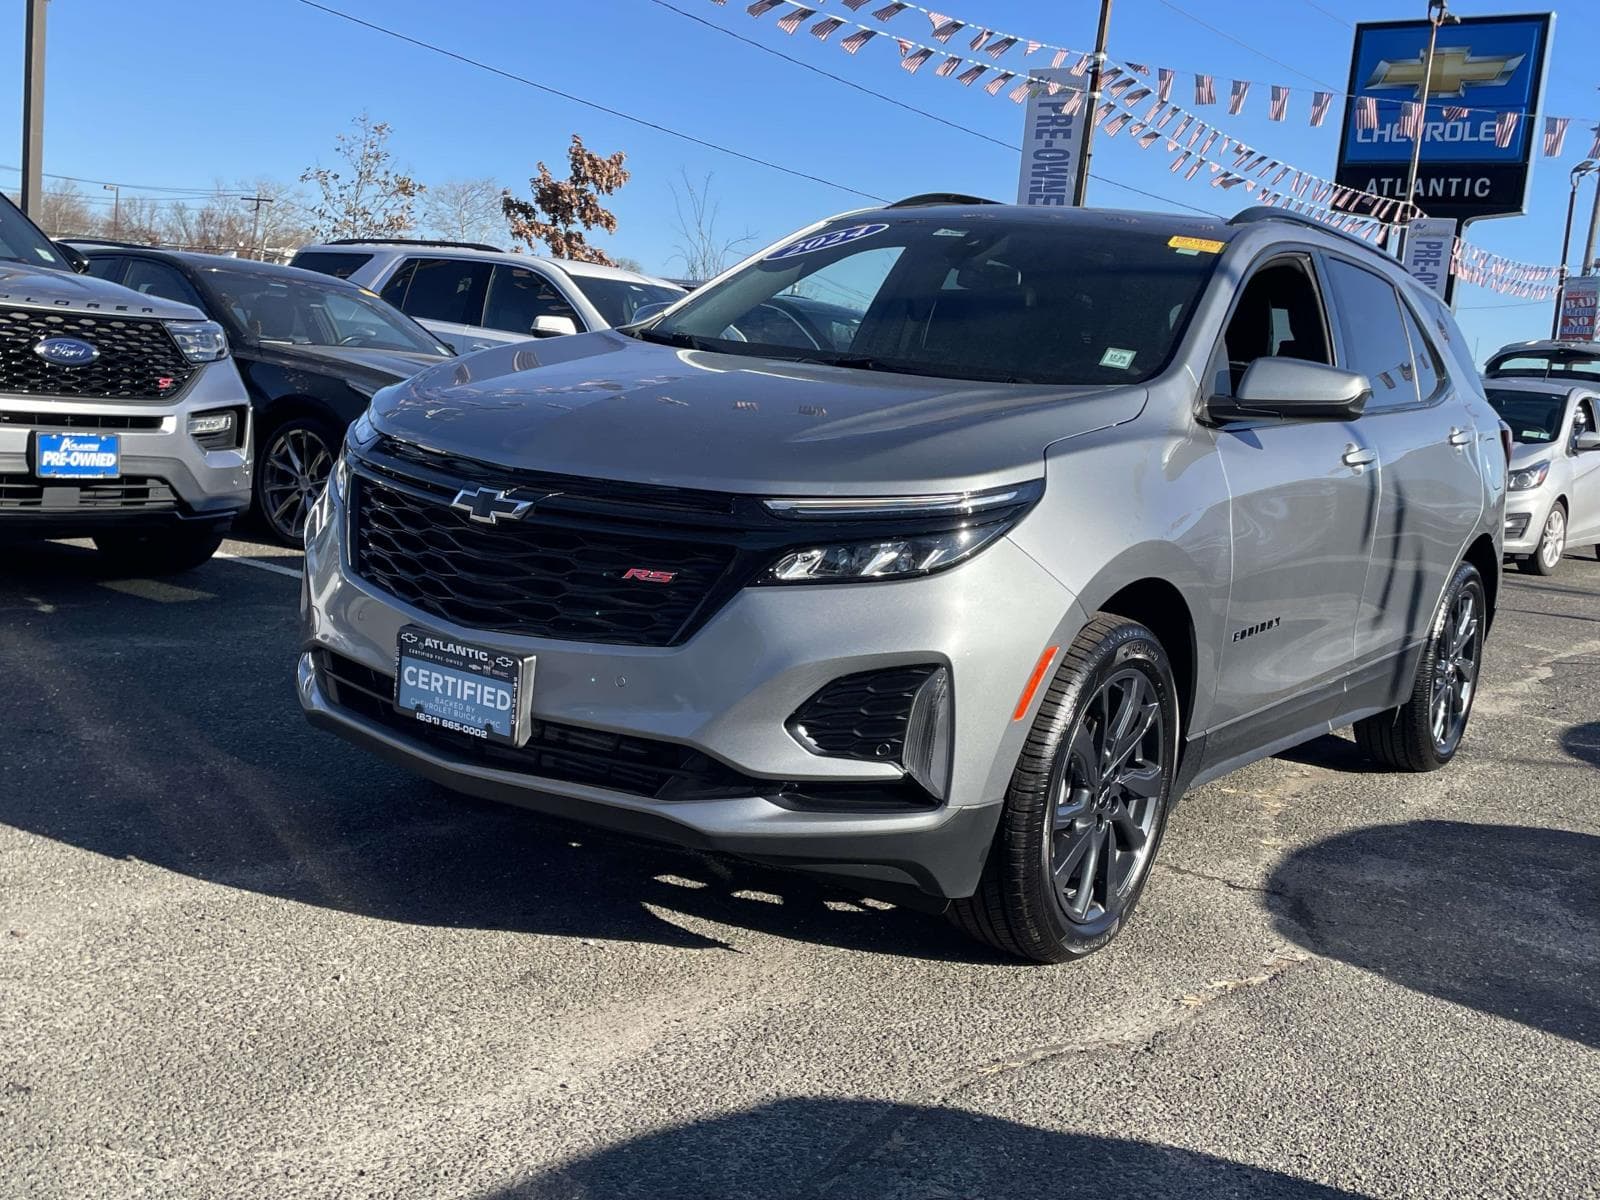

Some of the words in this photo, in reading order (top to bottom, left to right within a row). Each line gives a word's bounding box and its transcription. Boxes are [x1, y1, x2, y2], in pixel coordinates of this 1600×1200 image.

[1356, 121, 1512, 143] CHEROLE
[1028, 102, 1073, 206] PRE-OWNE
[1365, 177, 1491, 198] ATLANTIC
[783, 224, 870, 257] 2024
[54, 343, 85, 357] Ford
[42, 451, 117, 468] PRE-OWNED
[621, 567, 678, 583] RS
[425, 638, 488, 662] ATLANTIC
[404, 666, 511, 711] CERTIFIED
[453, 710, 475, 721] BUICK
[466, 704, 475, 713] BY
[415, 711, 441, 726] (631)
